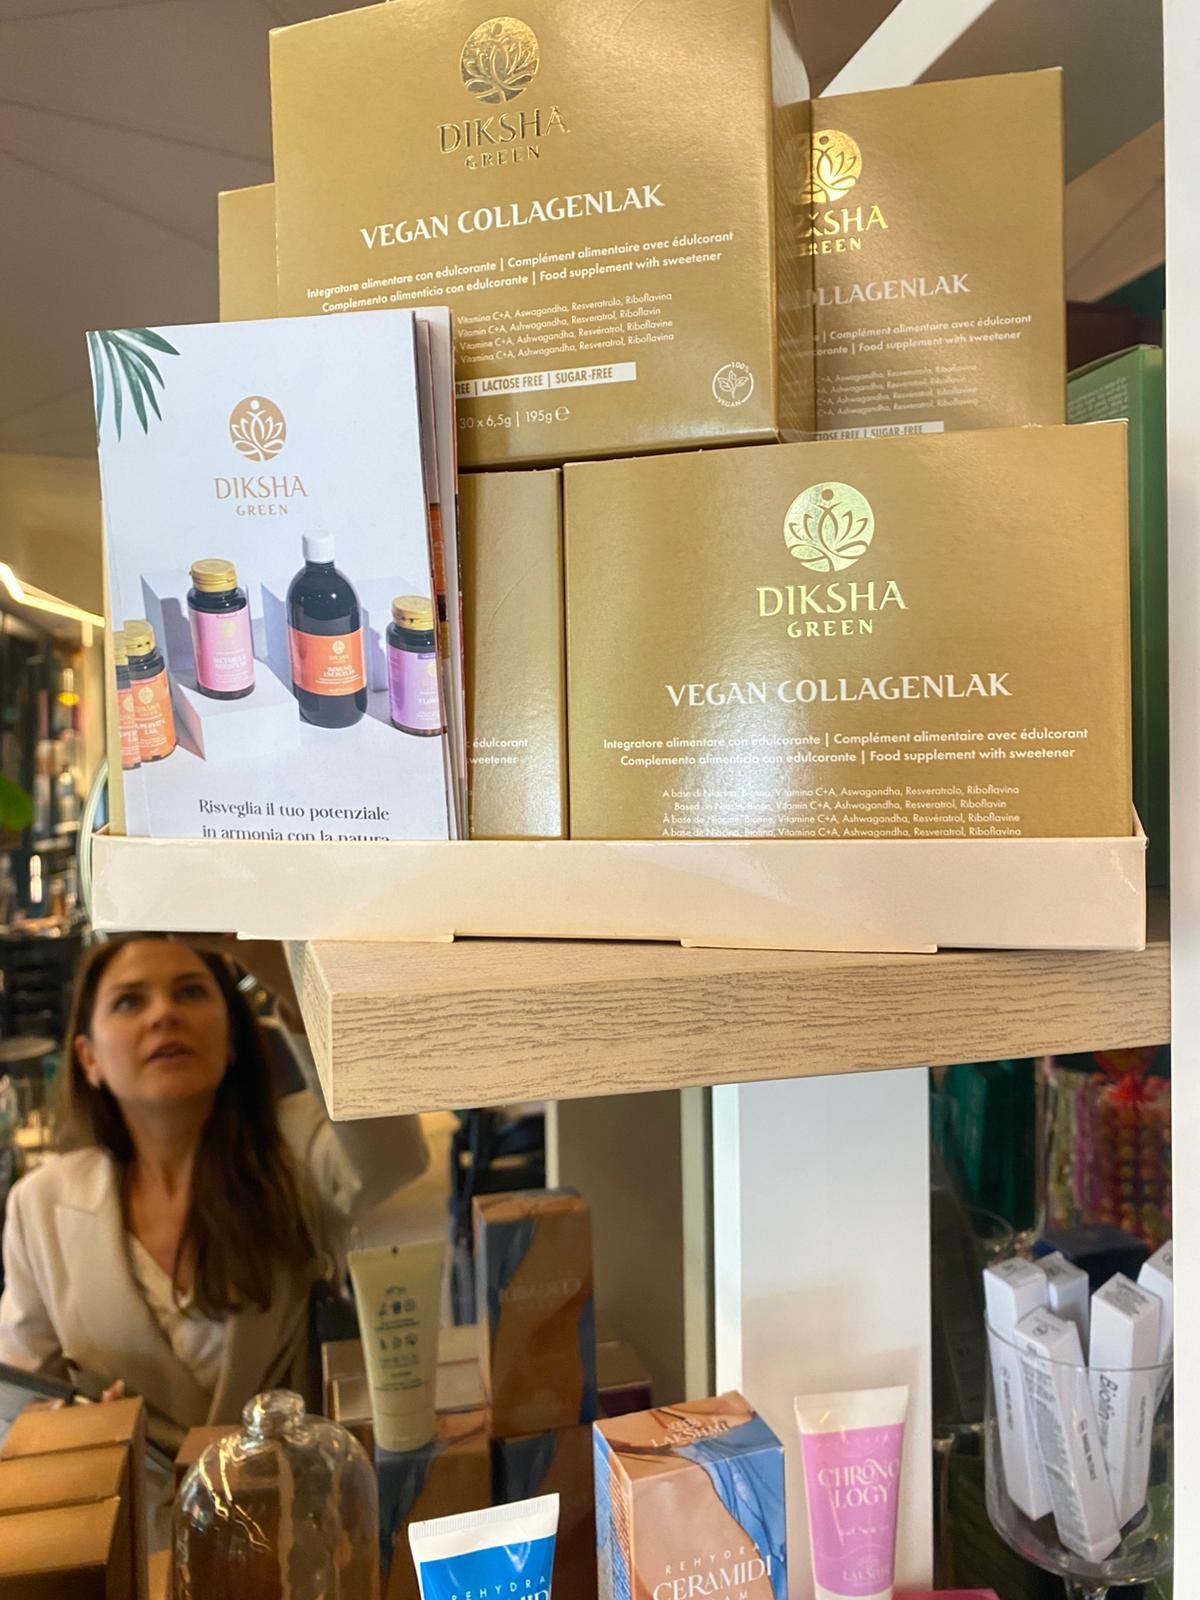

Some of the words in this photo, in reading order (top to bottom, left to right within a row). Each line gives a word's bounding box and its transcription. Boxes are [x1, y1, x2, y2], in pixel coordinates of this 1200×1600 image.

[437, 105, 571, 153] DIKSHA
[464, 145, 541, 169] GREEN
[360, 214, 449, 248] VEGAN
[457, 184, 665, 233] COLLAGENLAK
[808, 237, 861, 255] REEN
[307, 283, 359, 299] Integratore
[361, 274, 413, 289] alimentare
[415, 272, 433, 281] con
[436, 261, 496, 278] edulcorante
[508, 251, 575, 268] Complément
[578, 243, 640, 258] alimentaire
[642, 240, 669, 250] avec
[672, 231, 734, 247] édulcorant
[322, 294, 388, 313] Complemento
[390, 286, 443, 302] alimenticio
[446, 285, 464, 294] con
[466, 274, 528, 291] edulcorante
[540, 269, 567, 281] Food
[569, 261, 633, 279] supplement
[636, 256, 660, 269] with
[662, 252, 722, 266] sweetener
[625, 292, 672, 306] Riboflavina
[620, 307, 661, 319] Riboflavin
[627, 319, 673, 332] Riboflavine
[830, 325, 891, 342] Complément
[893, 321, 949, 334] alimentaire
[951, 319, 975, 329] avec
[977, 314, 1031, 327] édulcorant
[627, 331, 674, 345] Riboflavina
[816, 345, 848, 356] orante
[859, 340, 884, 352] Food
[886, 336, 942, 352] supplement
[943, 333, 967, 344] with
[969, 331, 1021, 342] sweetener
[456, 383, 470, 395] REE
[482, 377, 519, 392] LACTOSE
[523, 375, 543, 388] FREE
[555, 367, 613, 384] SUGAR-FREE
[459, 417, 473, 429] 30
[213, 475, 309, 499] DIKSHA
[236, 504, 288, 516] GREEN
[756, 580, 910, 616] DIKSHA
[787, 619, 873, 638] GREEN
[665, 681, 766, 707] VEGAN
[777, 672, 1014, 703] COLLAGENLAK
[473, 737, 528, 749] édulcorant
[603, 739, 663, 752] Integratore
[666, 736, 724, 749] alimentare
[728, 738, 748, 747] con
[751, 734, 820, 747] edulcorante
[834, 732, 910, 747] Complément
[913, 730, 984, 743] alimentaire
[987, 731, 1017, 741] avec
[1020, 728, 1088, 741] édulcorant
[468, 756, 519, 765] weetener
[620, 755, 695, 769] Complemento
[762, 754, 782, 764] con
[786, 751, 856, 764] edulcorante
[870, 750, 900, 762] Food
[904, 749, 976, 764] supplement
[979, 747, 1006, 760] with
[1009, 748, 1075, 760] sweetener
[840, 786, 903, 798] Aswagandha,
[905, 786, 964, 797] Resveratrolo,
[967, 785, 1020, 795] Riboflavina
[199, 799, 262, 818] Risveglia
[266, 802, 274, 816] il
[280, 805, 304, 817] tuo
[310, 806, 390, 821] potenziale
[834, 800, 903, 811] Ashwagandha,
[905, 799, 958, 810] Resveratrol,
[961, 799, 1006, 808] Riboflavin
[843, 814, 911, 825] Ashwagandha,
[968, 812, 1020, 822] Riboflavine
[202, 825, 216, 838] in
[221, 828, 283, 840] armonia
[287, 832, 315, 840] con
[320, 830, 333, 841] la
[843, 827, 911, 839] Ashwagandha,
[914, 827, 966, 838] Resveratrol,
[969, 826, 1021, 837] Riboflavina
[651, 1419, 729, 1448] LAKSHMI
[834, 1486, 888, 1509] LOGY
[665, 1542, 760, 1575] REHYDRA
[452, 1575, 545, 1600] REHYDRA
[652, 1554, 772, 1600] CERAMIDI
